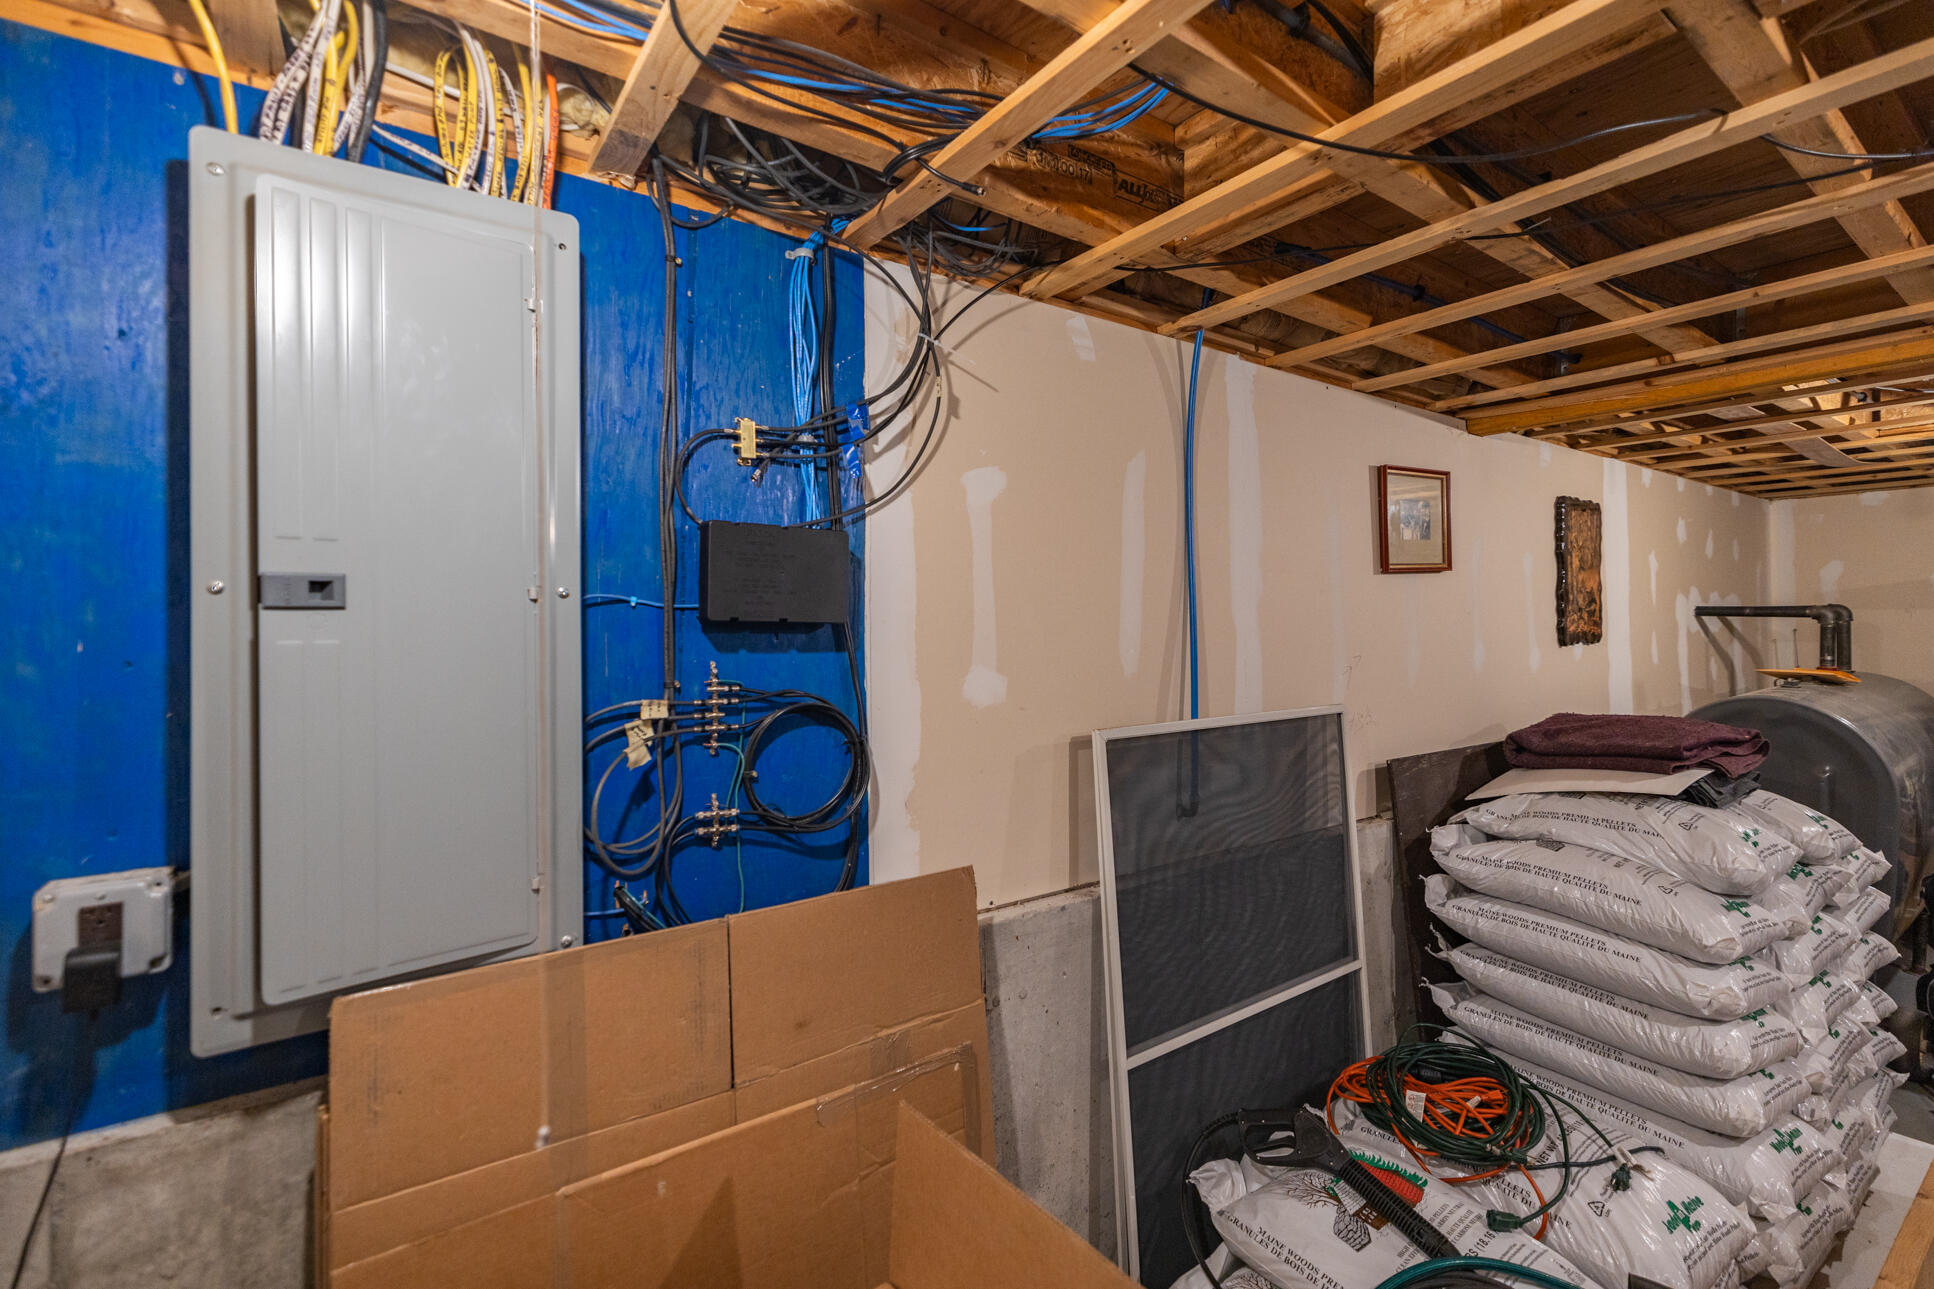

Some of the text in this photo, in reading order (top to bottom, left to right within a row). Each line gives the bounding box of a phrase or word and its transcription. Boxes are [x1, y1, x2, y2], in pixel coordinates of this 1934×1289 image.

[1563, 816, 1589, 825] HAUTE
[1601, 817, 1636, 828] PELLETS
[1522, 867, 1533, 875] DE
[1534, 870, 1559, 881] HAUTE
[1562, 877, 1597, 892] QUALITE
[1599, 887, 1612, 896] DU
[1614, 891, 1642, 906] MAINE
[1533, 864, 1571, 880] PREMIUM
[1572, 874, 1609, 889] PELLETS
[1501, 913, 1529, 924] WOODS
[1530, 919, 1568, 935] PREMIUM
[1570, 931, 1606, 946] PELLETS
[1501, 918, 1519, 926] BOIS
[1520, 922, 1531, 930] DE
[1532, 925, 1558, 938] HAUTE
[1559, 933, 1595, 950] QUALITE
[1597, 946, 1610, 954] DU
[1612, 949, 1641, 963] MAINE
[1497, 963, 1508, 971] DE
[1509, 966, 1527, 977] BOIS
[1529, 973, 1539, 981] DE
[1541, 976, 1568, 990] HAUTE
[1568, 986, 1603, 1003] QUALITE
[1606, 999, 1618, 1008] DU
[1620, 1004, 1650, 1020] MAINE
[1511, 961, 1538, 974] WOODS
[1539, 970, 1578, 987] PREMIUM
[1579, 983, 1616, 1001] PELLETS
[1491, 1008, 1624, 1056] MAINE WOODS PREMIUM PELLETS
[1503, 1018, 1514, 1027] DE
[1515, 1021, 1534, 1033] BOIS
[1535, 1028, 1545, 1037] DE
[1547, 1032, 1575, 1048] HAUTE
[1576, 1042, 1612, 1060] QUALITE
[1614, 1056, 1627, 1064] DU
[1629, 1060, 1659, 1076] MAINE
[1536, 1073, 1565, 1089] WOODS
[1567, 1086, 1607, 1107] PREMIUM
[1608, 1103, 1649, 1124] PELLETS
[1536, 1080, 1686, 1149] BOIS DE HAUTE QUALITE DU MAINE
[1536, 1150, 1551, 1165] NET
[1227, 1215, 1320, 1287] GRANULES DE BOIS DE
[1258, 1226, 1287, 1250] MAINE
[1287, 1248, 1320, 1276] WOODS
